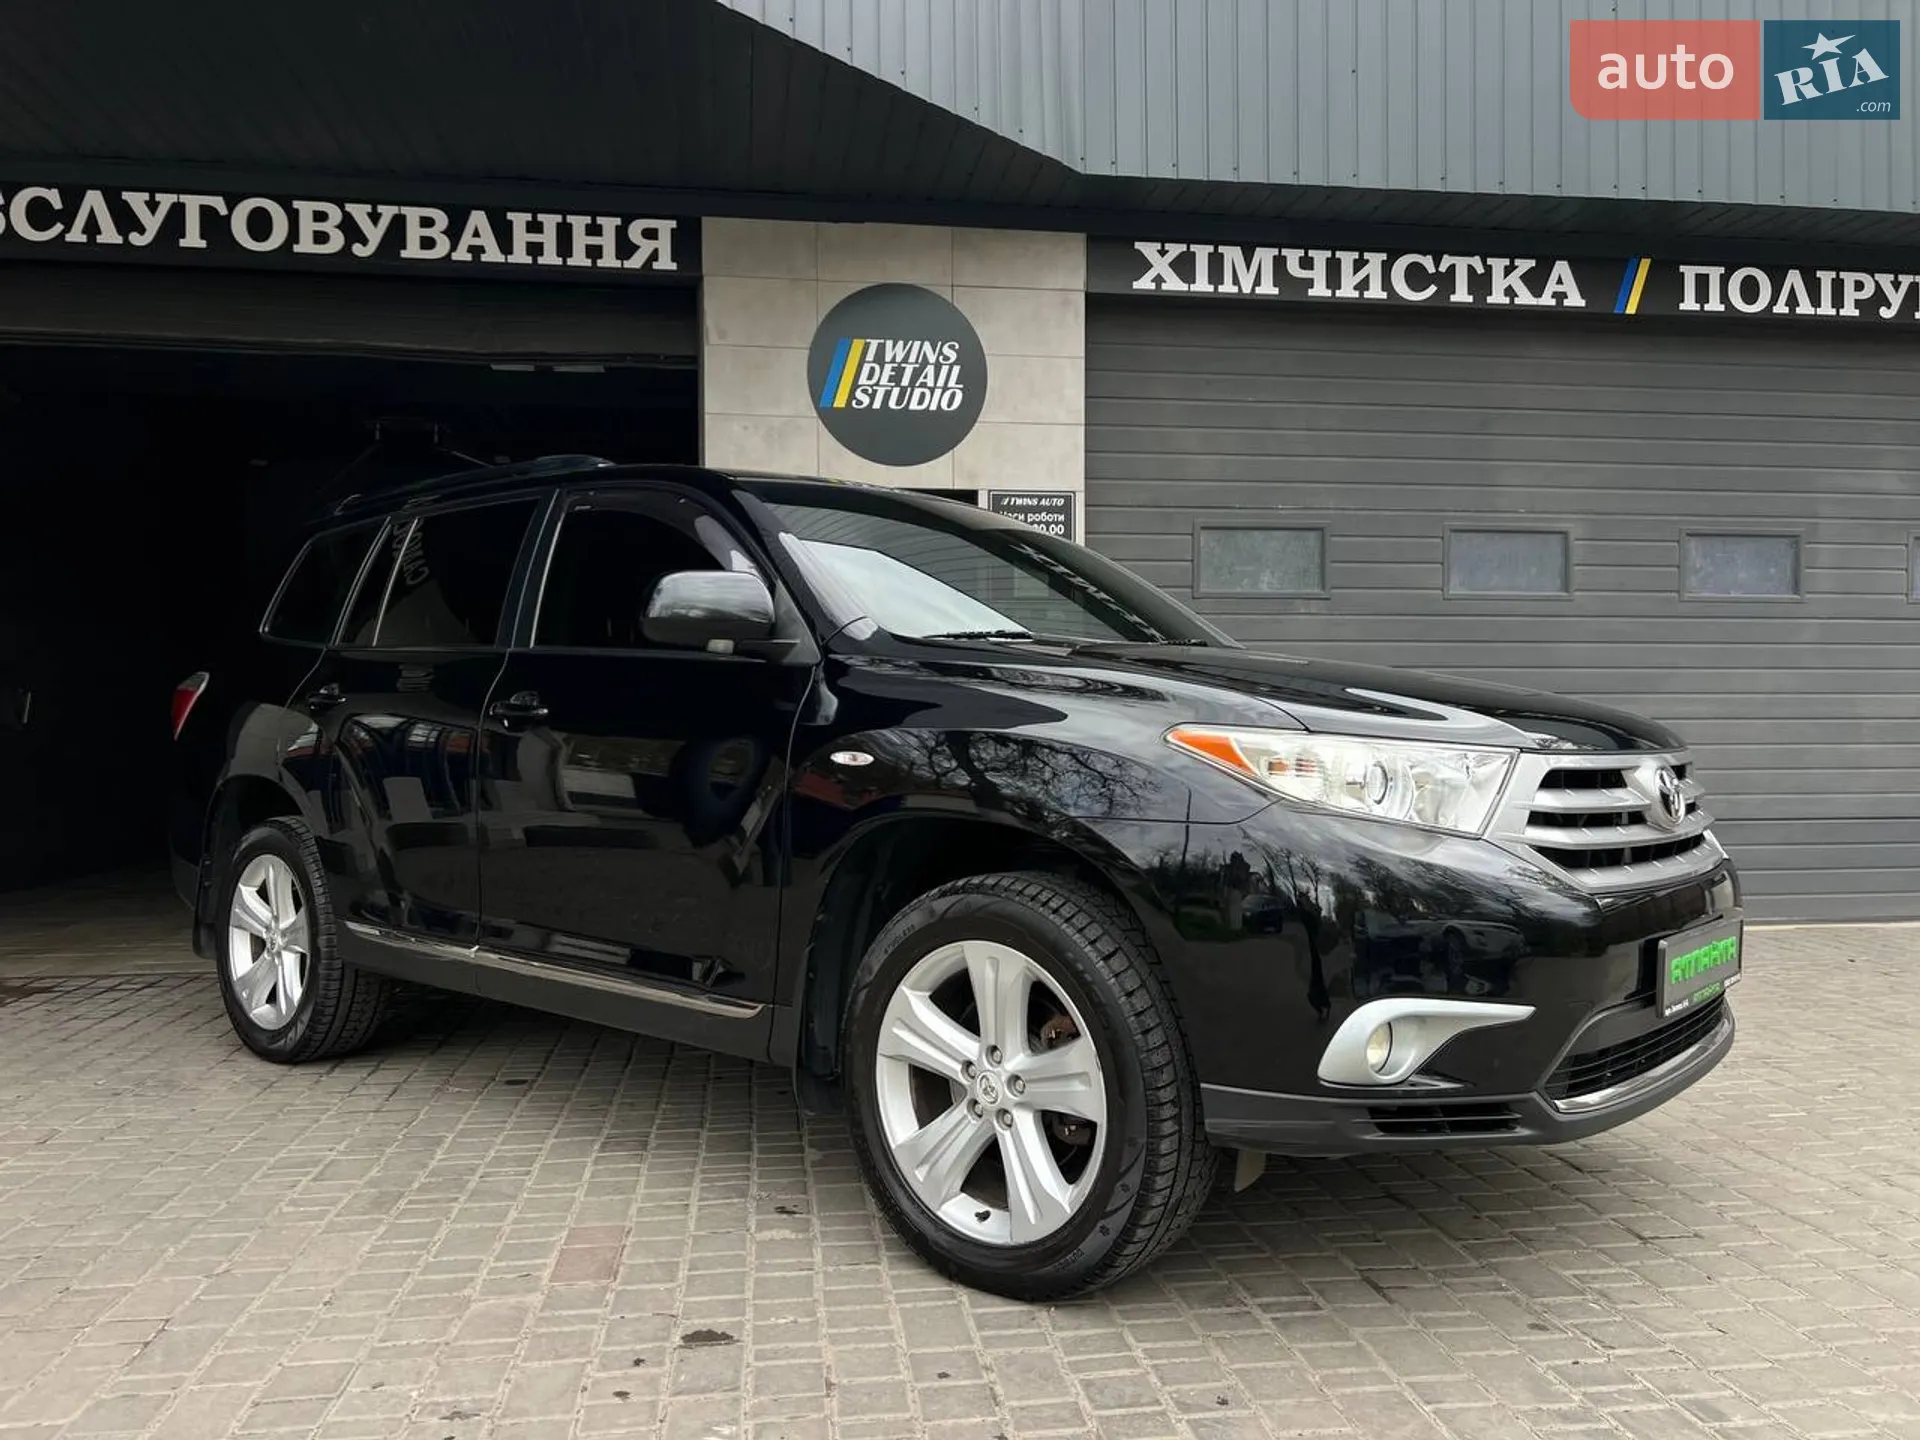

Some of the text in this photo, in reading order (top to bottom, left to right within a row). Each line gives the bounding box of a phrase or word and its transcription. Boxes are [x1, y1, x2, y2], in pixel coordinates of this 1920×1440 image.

[0, 186, 678, 271] СЛУГОВУВАННЯ
[1132, 241, 1920, 319] ХІМЧИСТКА ПОЛІРУ
[864, 338, 960, 365] TWINS
[857, 362, 964, 388] DETAIL
[851, 385, 964, 411] STUDIO
[1010, 497, 1065, 507] TWINS AUTO
[1027, 511, 1065, 523] роботи
